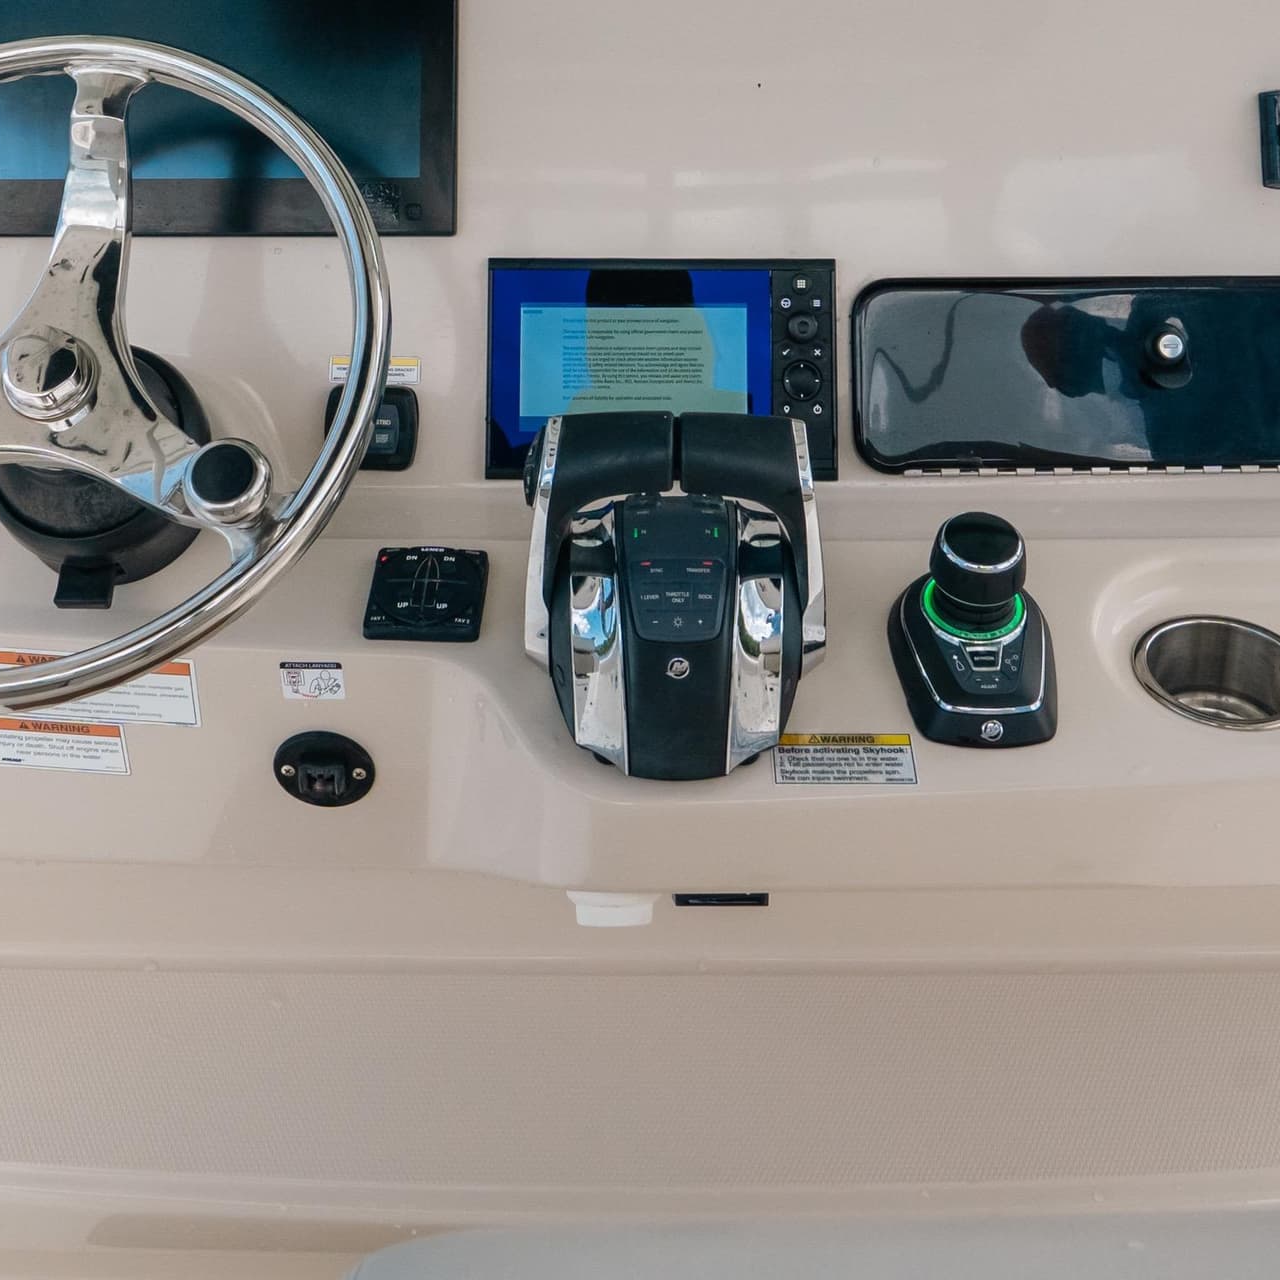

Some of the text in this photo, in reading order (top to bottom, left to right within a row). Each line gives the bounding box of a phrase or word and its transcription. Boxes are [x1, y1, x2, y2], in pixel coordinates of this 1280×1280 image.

[31, 720, 90, 733] WARNING
[820, 735, 876, 743] WARNING
[778, 746, 810, 754] Before
[813, 746, 860, 755] activating
